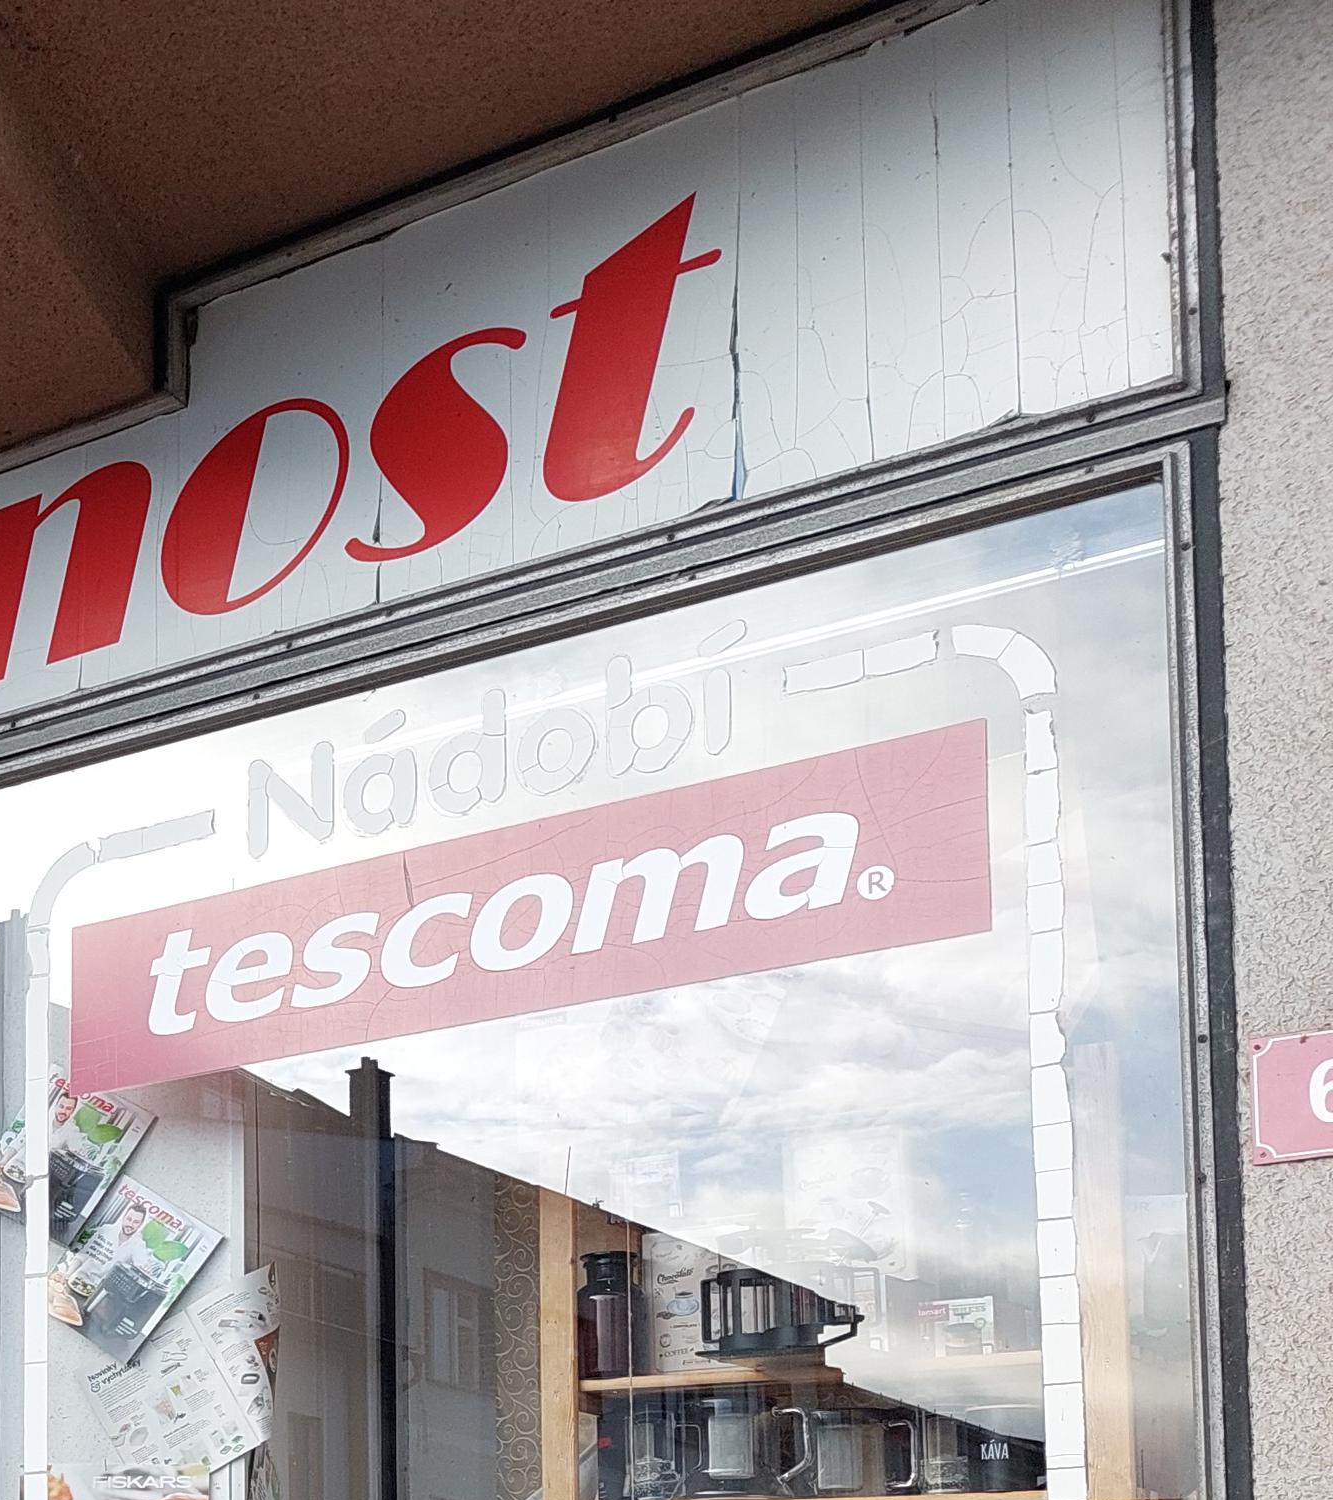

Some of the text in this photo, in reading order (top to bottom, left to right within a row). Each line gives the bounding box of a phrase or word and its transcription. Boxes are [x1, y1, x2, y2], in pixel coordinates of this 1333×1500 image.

[246, 618, 747, 860] Nádobí
[980, 1438, 1010, 1461] KÁVA
[92, 1475, 194, 1490] FISKARS
